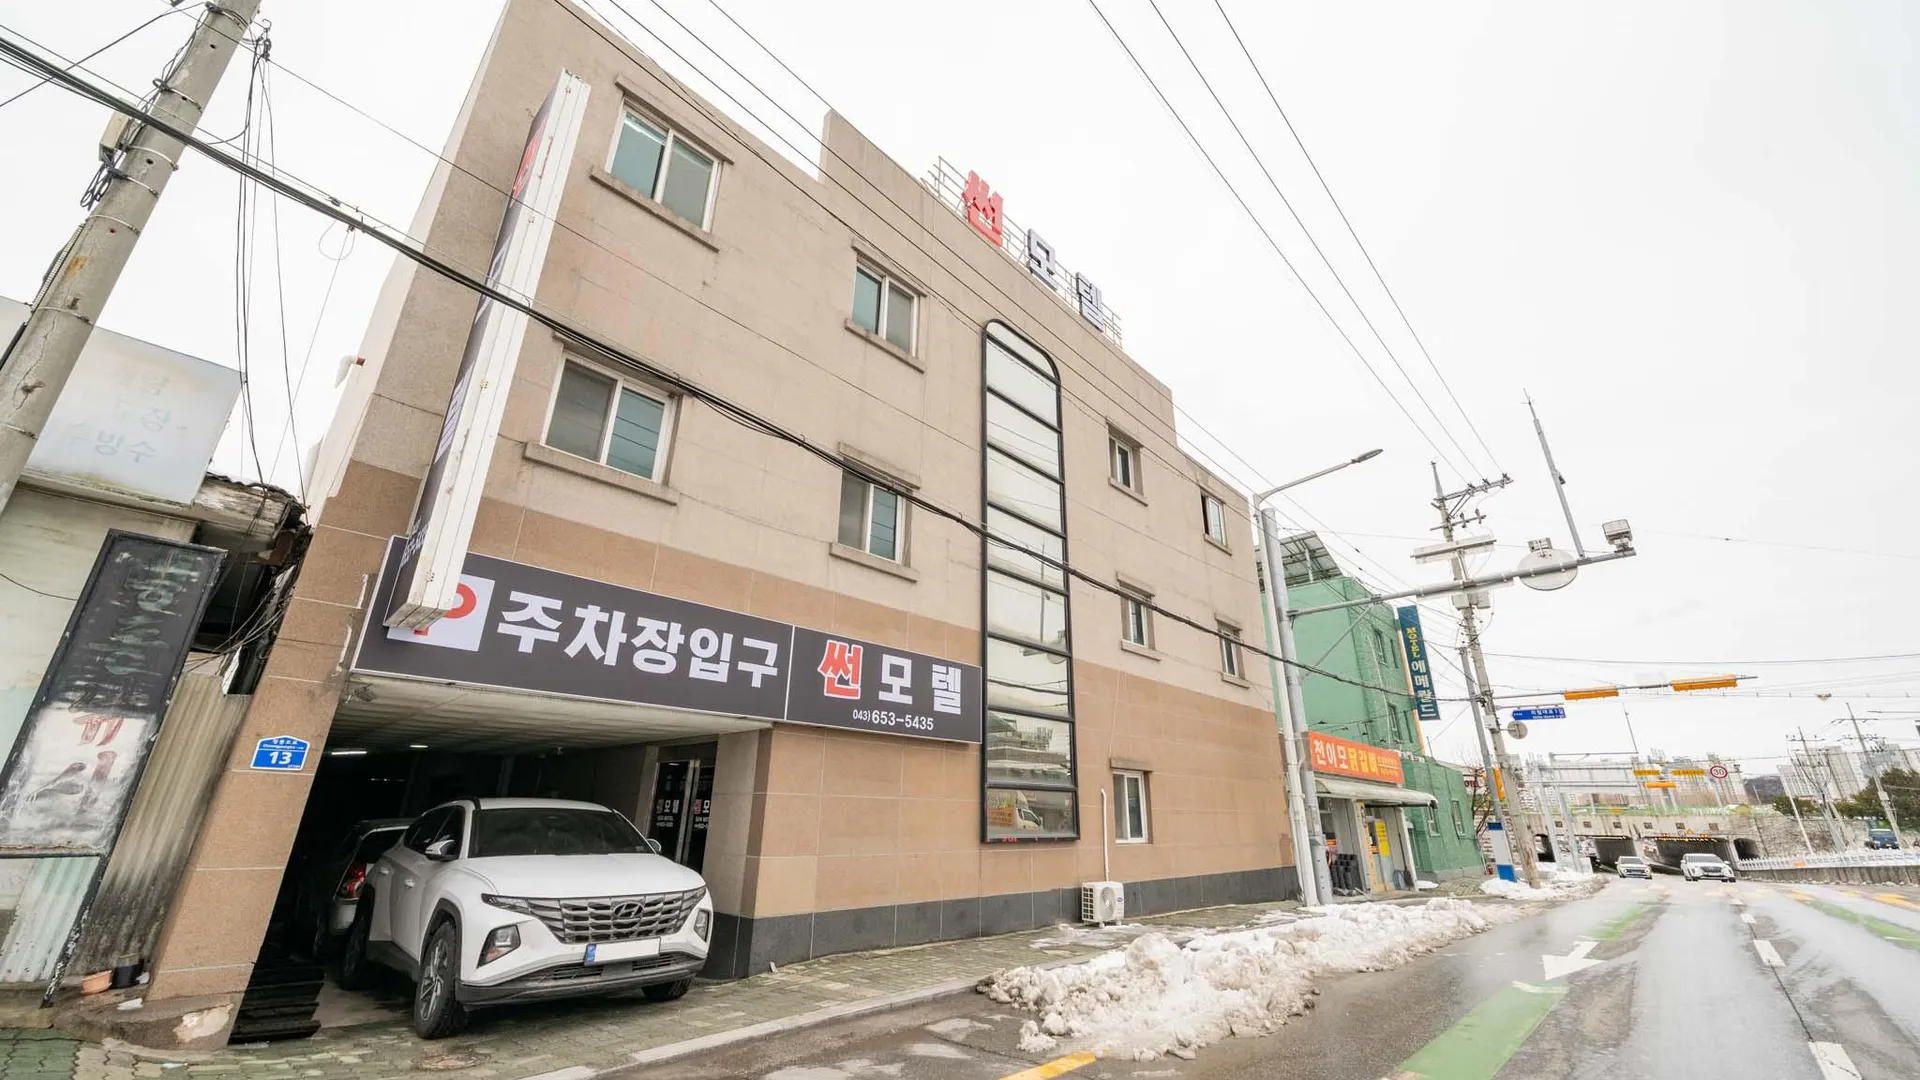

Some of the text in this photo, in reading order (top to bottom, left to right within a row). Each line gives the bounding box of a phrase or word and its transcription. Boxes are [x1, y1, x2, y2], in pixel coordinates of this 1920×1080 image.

[496, 589, 780, 689] 주차장입구
[1406, 627, 1420, 658] MOTEL
[269, 751, 292, 765] 13
